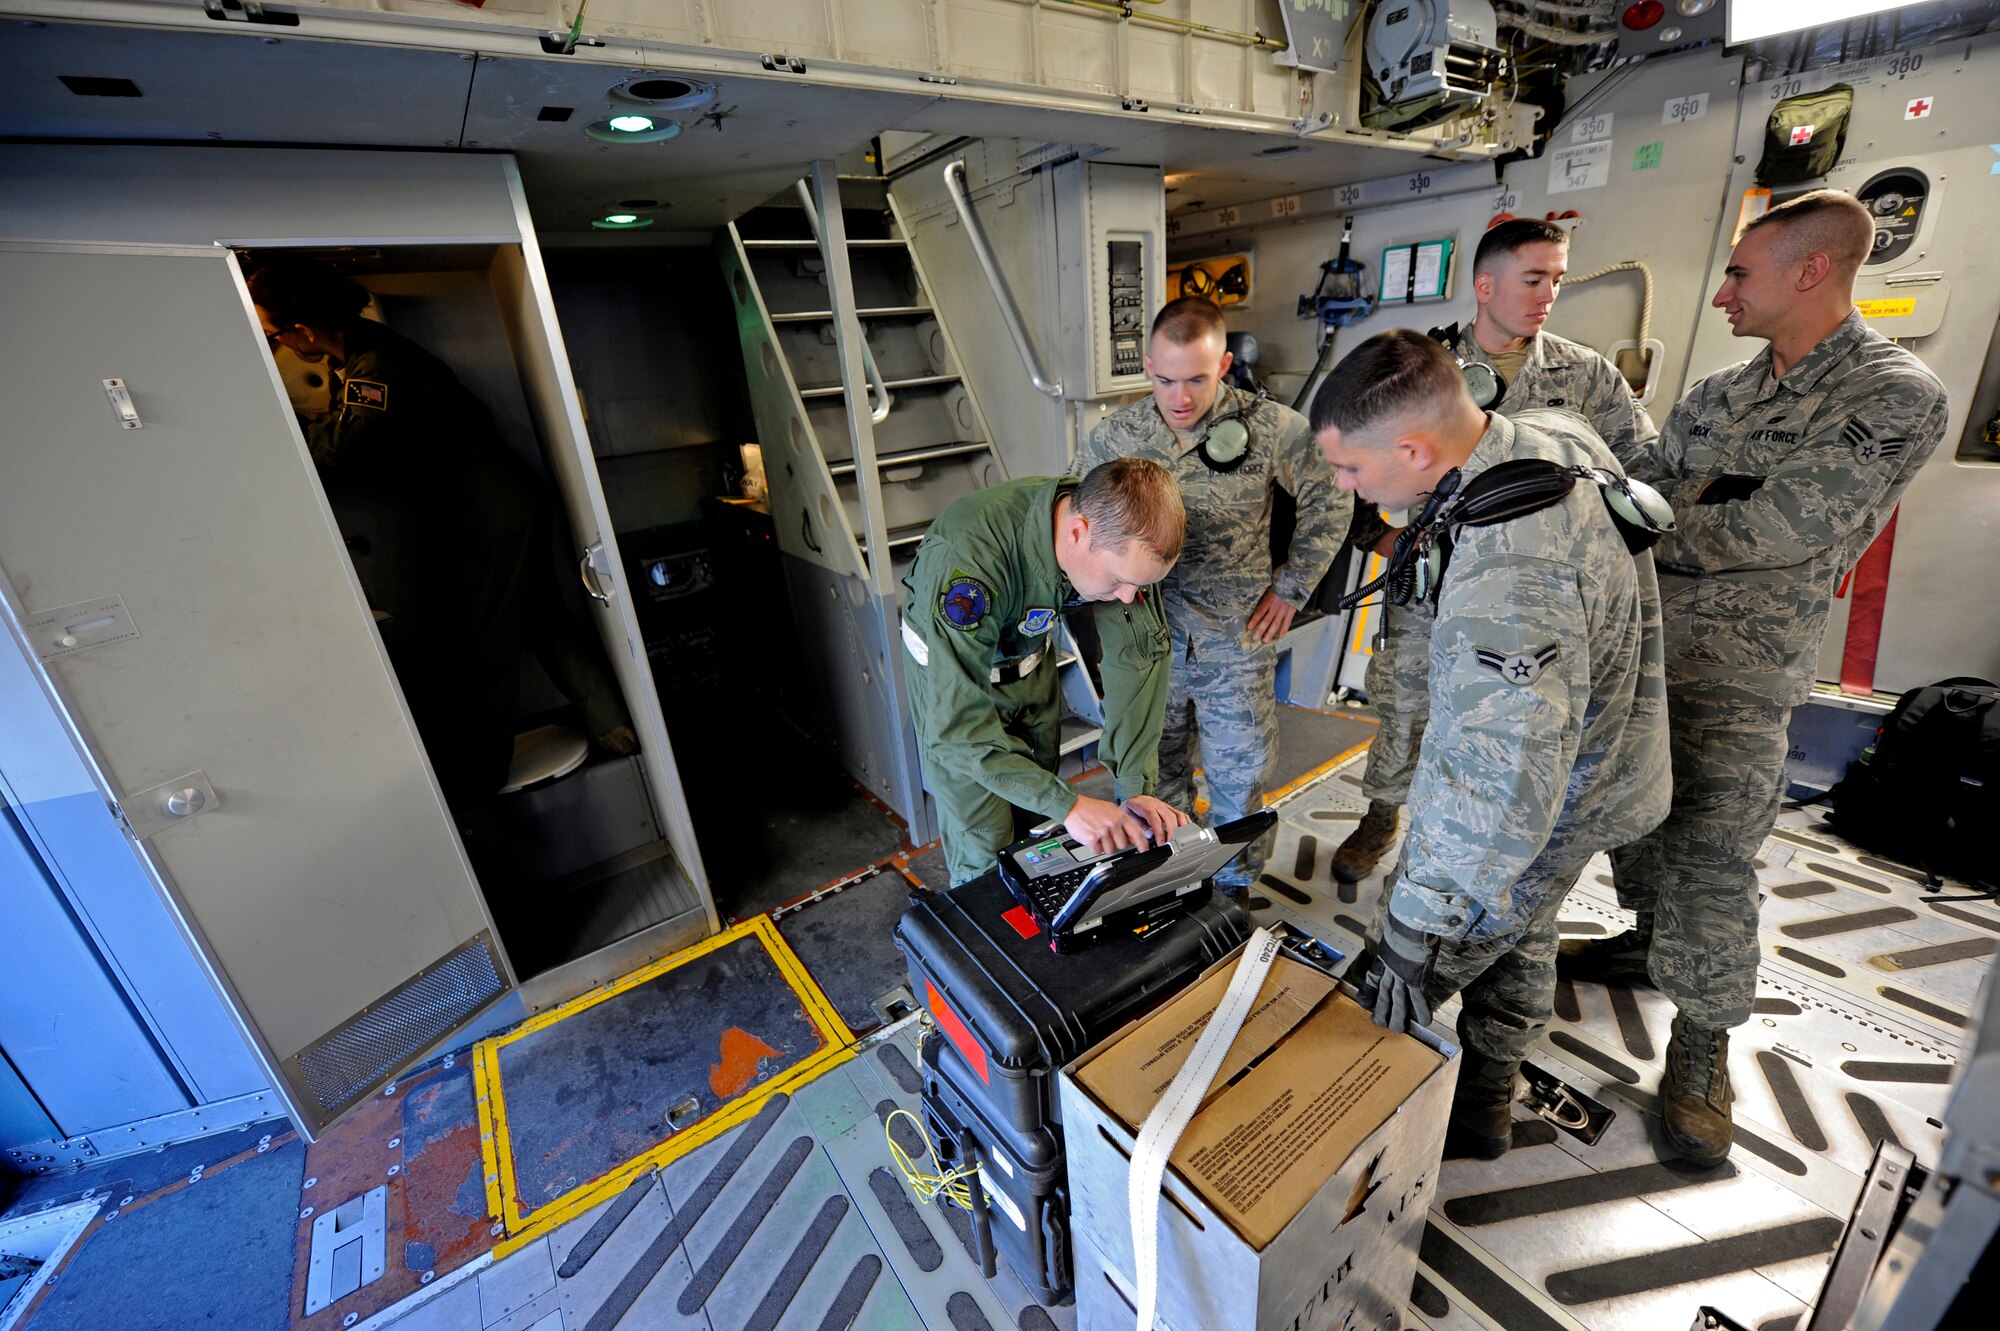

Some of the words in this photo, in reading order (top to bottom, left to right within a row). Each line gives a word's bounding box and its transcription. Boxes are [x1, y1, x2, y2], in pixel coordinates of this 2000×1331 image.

[1887, 54, 1923, 76] 380
[1770, 80, 1801, 100] 370
[1672, 99, 1699, 118] 360
[1580, 119, 1605, 137] 350
[1555, 145, 1608, 161] COMPARTMENT
[1409, 177, 1431, 191] 330
[1567, 175, 1588, 188] 347
[1340, 188, 1360, 202] 320
[1494, 194, 1515, 210] 340
[1276, 200, 1295, 213] 310
[1218, 211, 1236, 224] 300
[1765, 430, 1798, 444] FORCE
[1240, 463, 1265, 475] FORCE
[1192, 1009, 1213, 1026] MEDICINAL
[1175, 1028, 1187, 1039] FOOD
[1180, 1024, 1200, 1041] HARMFUL
[1164, 1041, 1178, 1053] TAKEN
